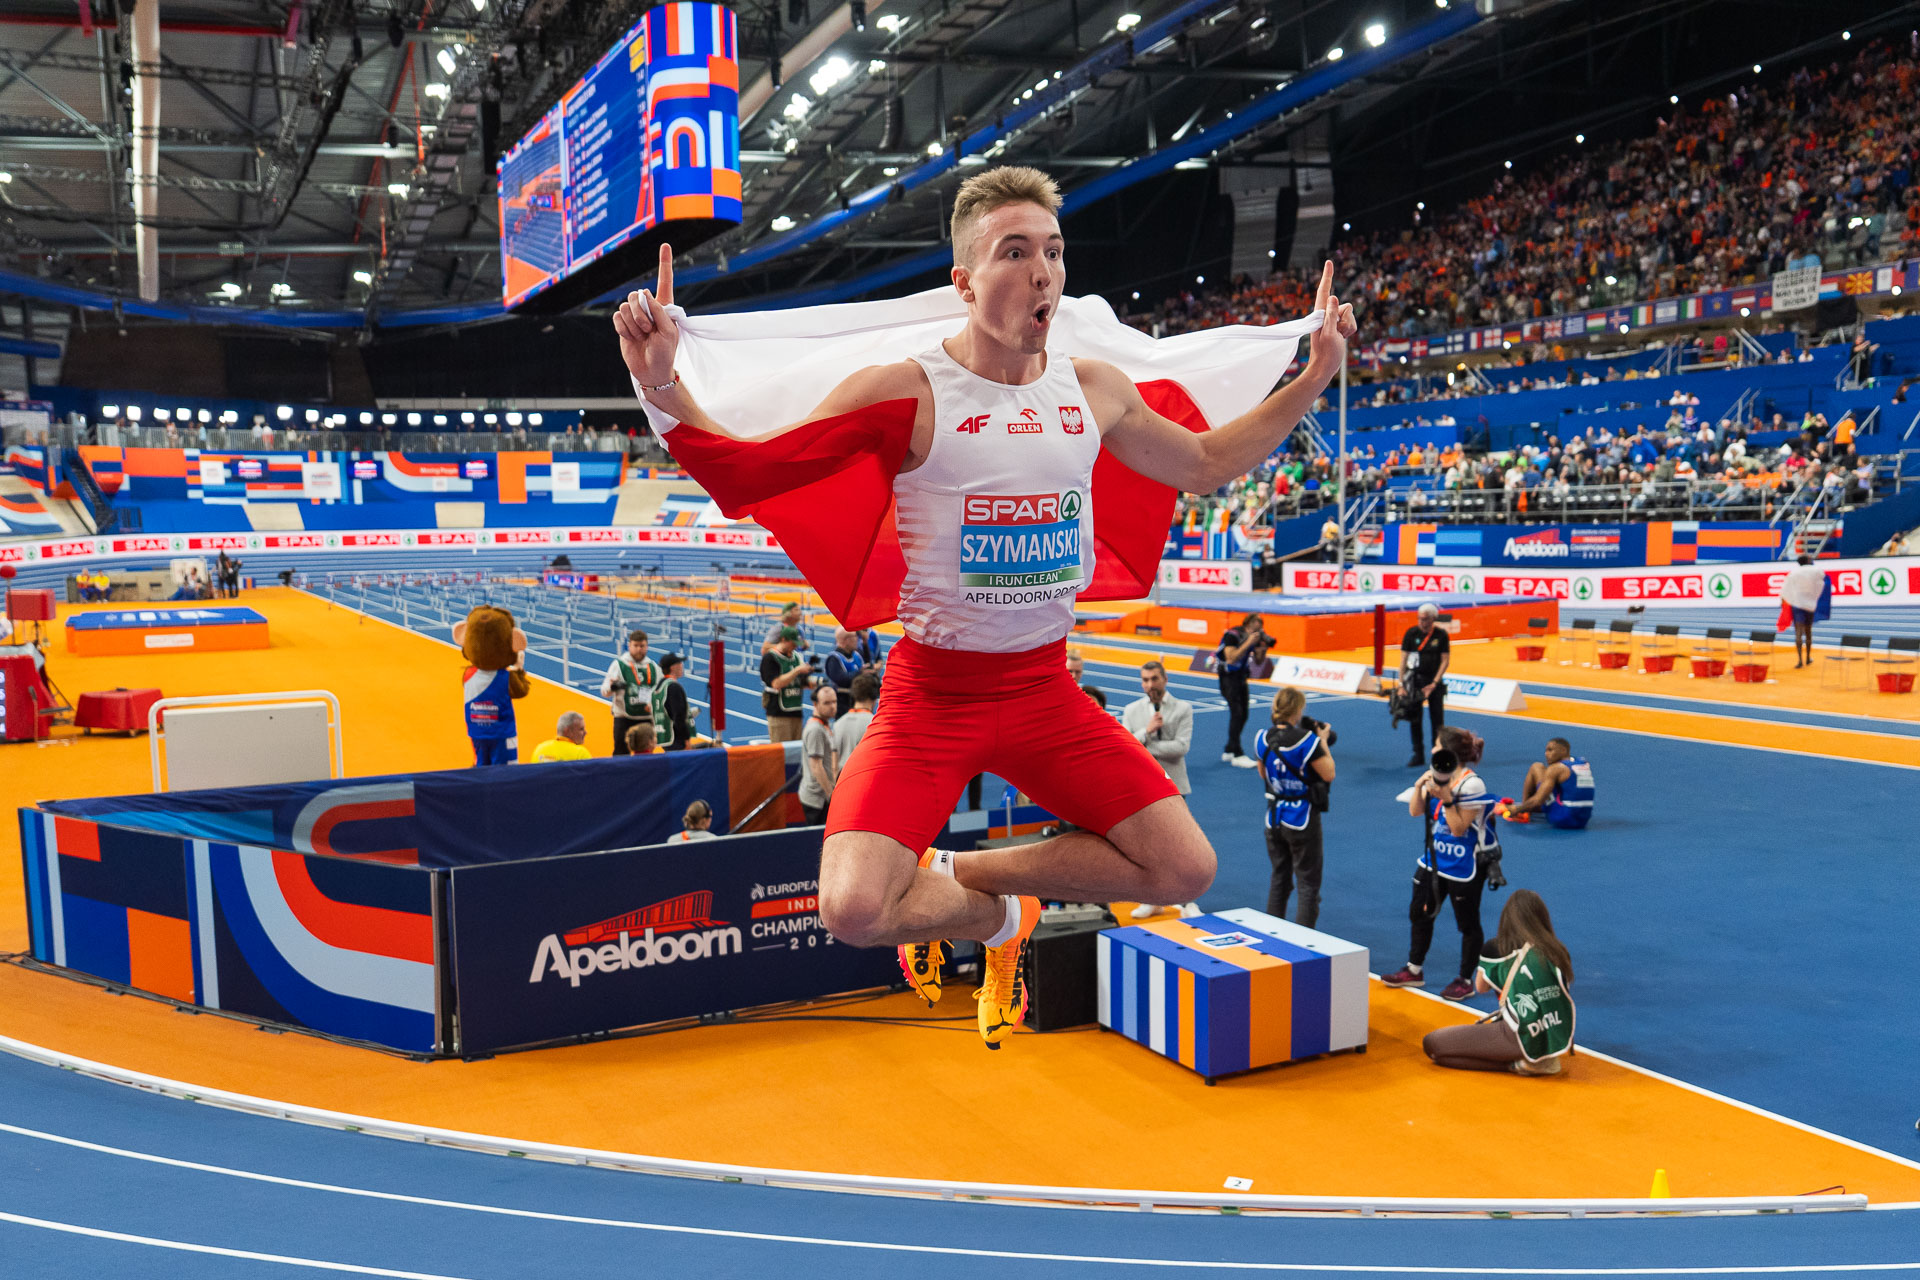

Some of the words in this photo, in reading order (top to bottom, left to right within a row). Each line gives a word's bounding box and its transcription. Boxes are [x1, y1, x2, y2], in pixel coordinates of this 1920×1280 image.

[956, 414, 991, 434] 4F
[1009, 424, 1040, 433] ORLEN
[967, 497, 1058, 522] SPAR
[200, 537, 246, 549] SPAR
[277, 536, 324, 547] SPAR
[355, 535, 400, 545] SPAR
[430, 534, 476, 544] SPAR
[507, 532, 550, 542] SPAR
[581, 531, 622, 541] SPAR
[650, 531, 689, 542] SPAR
[715, 533, 752, 544] SPAR
[52, 542, 93, 556] SPAR
[124, 538, 169, 551] SPAR
[962, 528, 1078, 563] SZYMANSKI
[1503, 537, 1568, 560] Apeldoorn
[989, 576, 993, 585] I
[995, 575, 1022, 586] RUN
[1189, 568, 1228, 584] SPAR
[1307, 572, 1357, 590] SPAR
[1397, 575, 1454, 592] SPAR
[1502, 578, 1568, 597] SPAR
[1623, 577, 1702, 597] SPAR
[1767, 573, 1861, 595] SR
[965, 590, 1052, 605] APELDOORN
[767, 880, 819, 896] EUROPEA
[788, 897, 819, 911] IND
[790, 933, 834, 950] 202
[529, 926, 743, 988] Apeldoorn
[1233, 1179, 1242, 1187] 2
